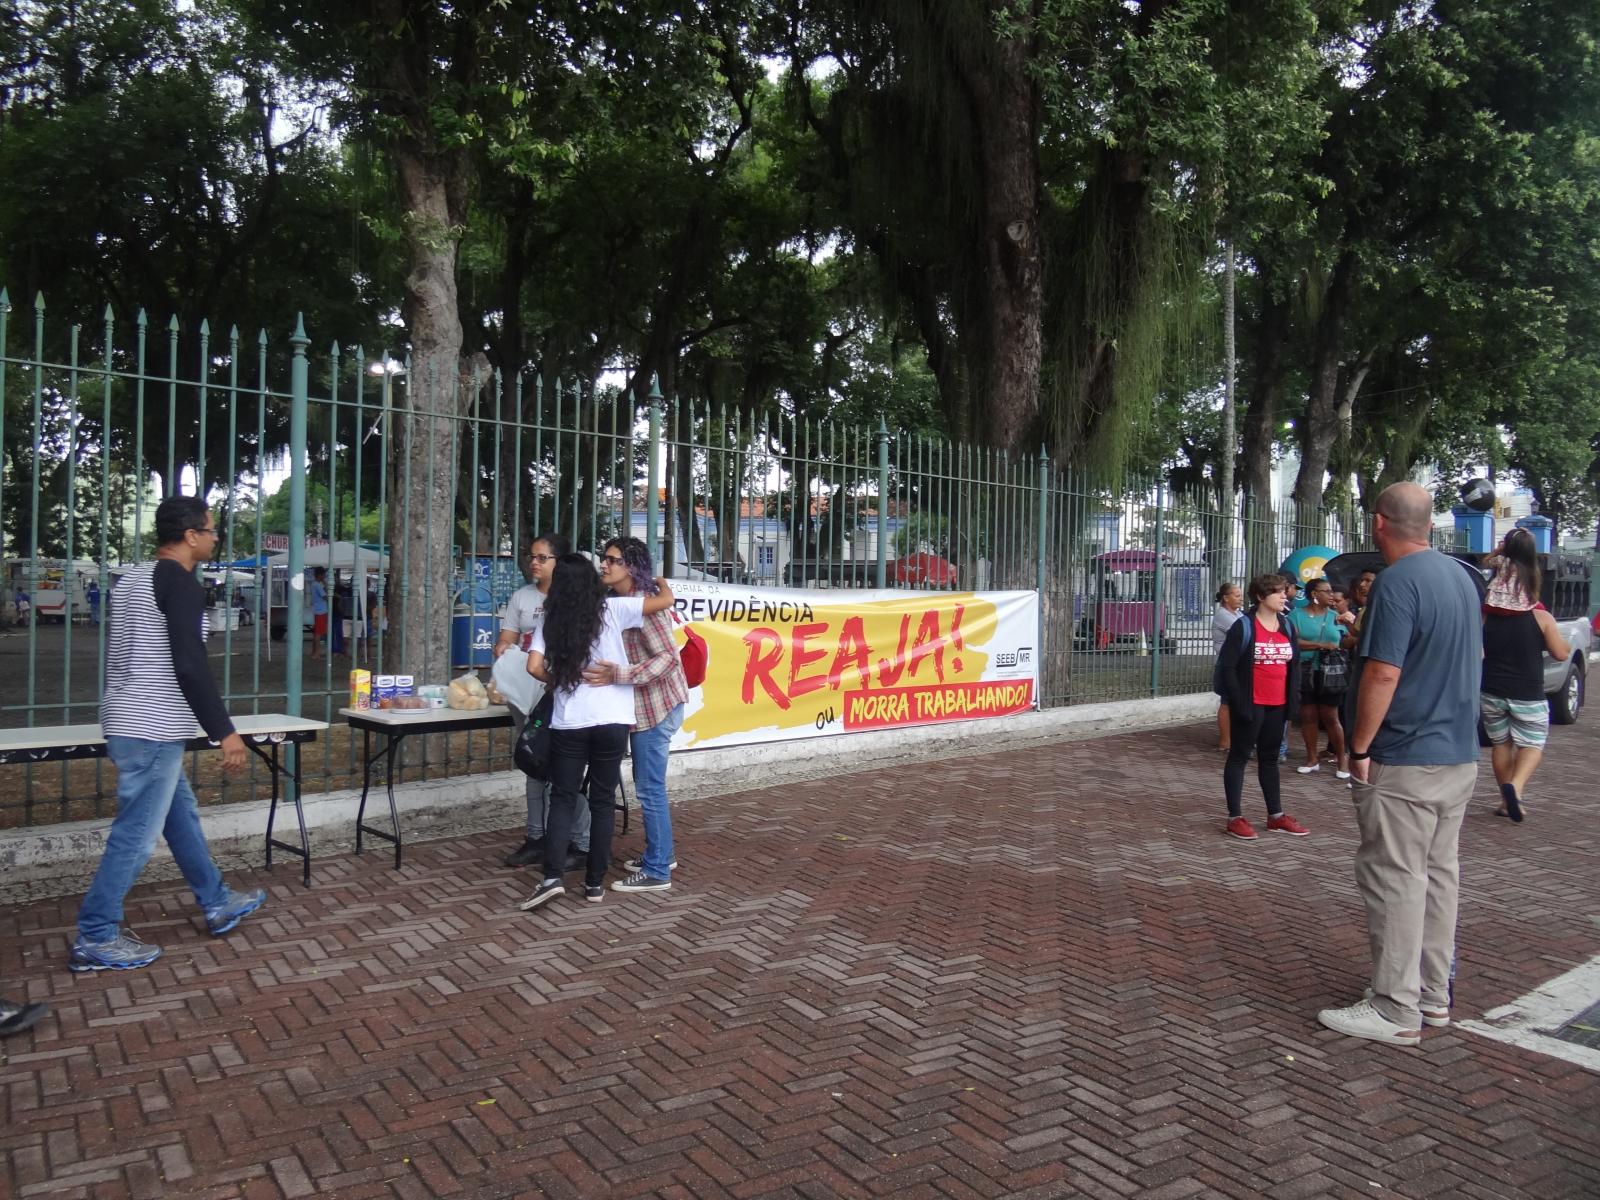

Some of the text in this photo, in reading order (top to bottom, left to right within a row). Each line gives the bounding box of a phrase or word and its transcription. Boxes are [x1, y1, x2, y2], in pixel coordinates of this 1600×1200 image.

[670, 583, 721, 594] FORMA DA
[673, 595, 814, 623] REVIDÊNCIA
[741, 603, 965, 710] REAJA!
[849, 683, 1029, 723] MORRA TRABALHANDO!
